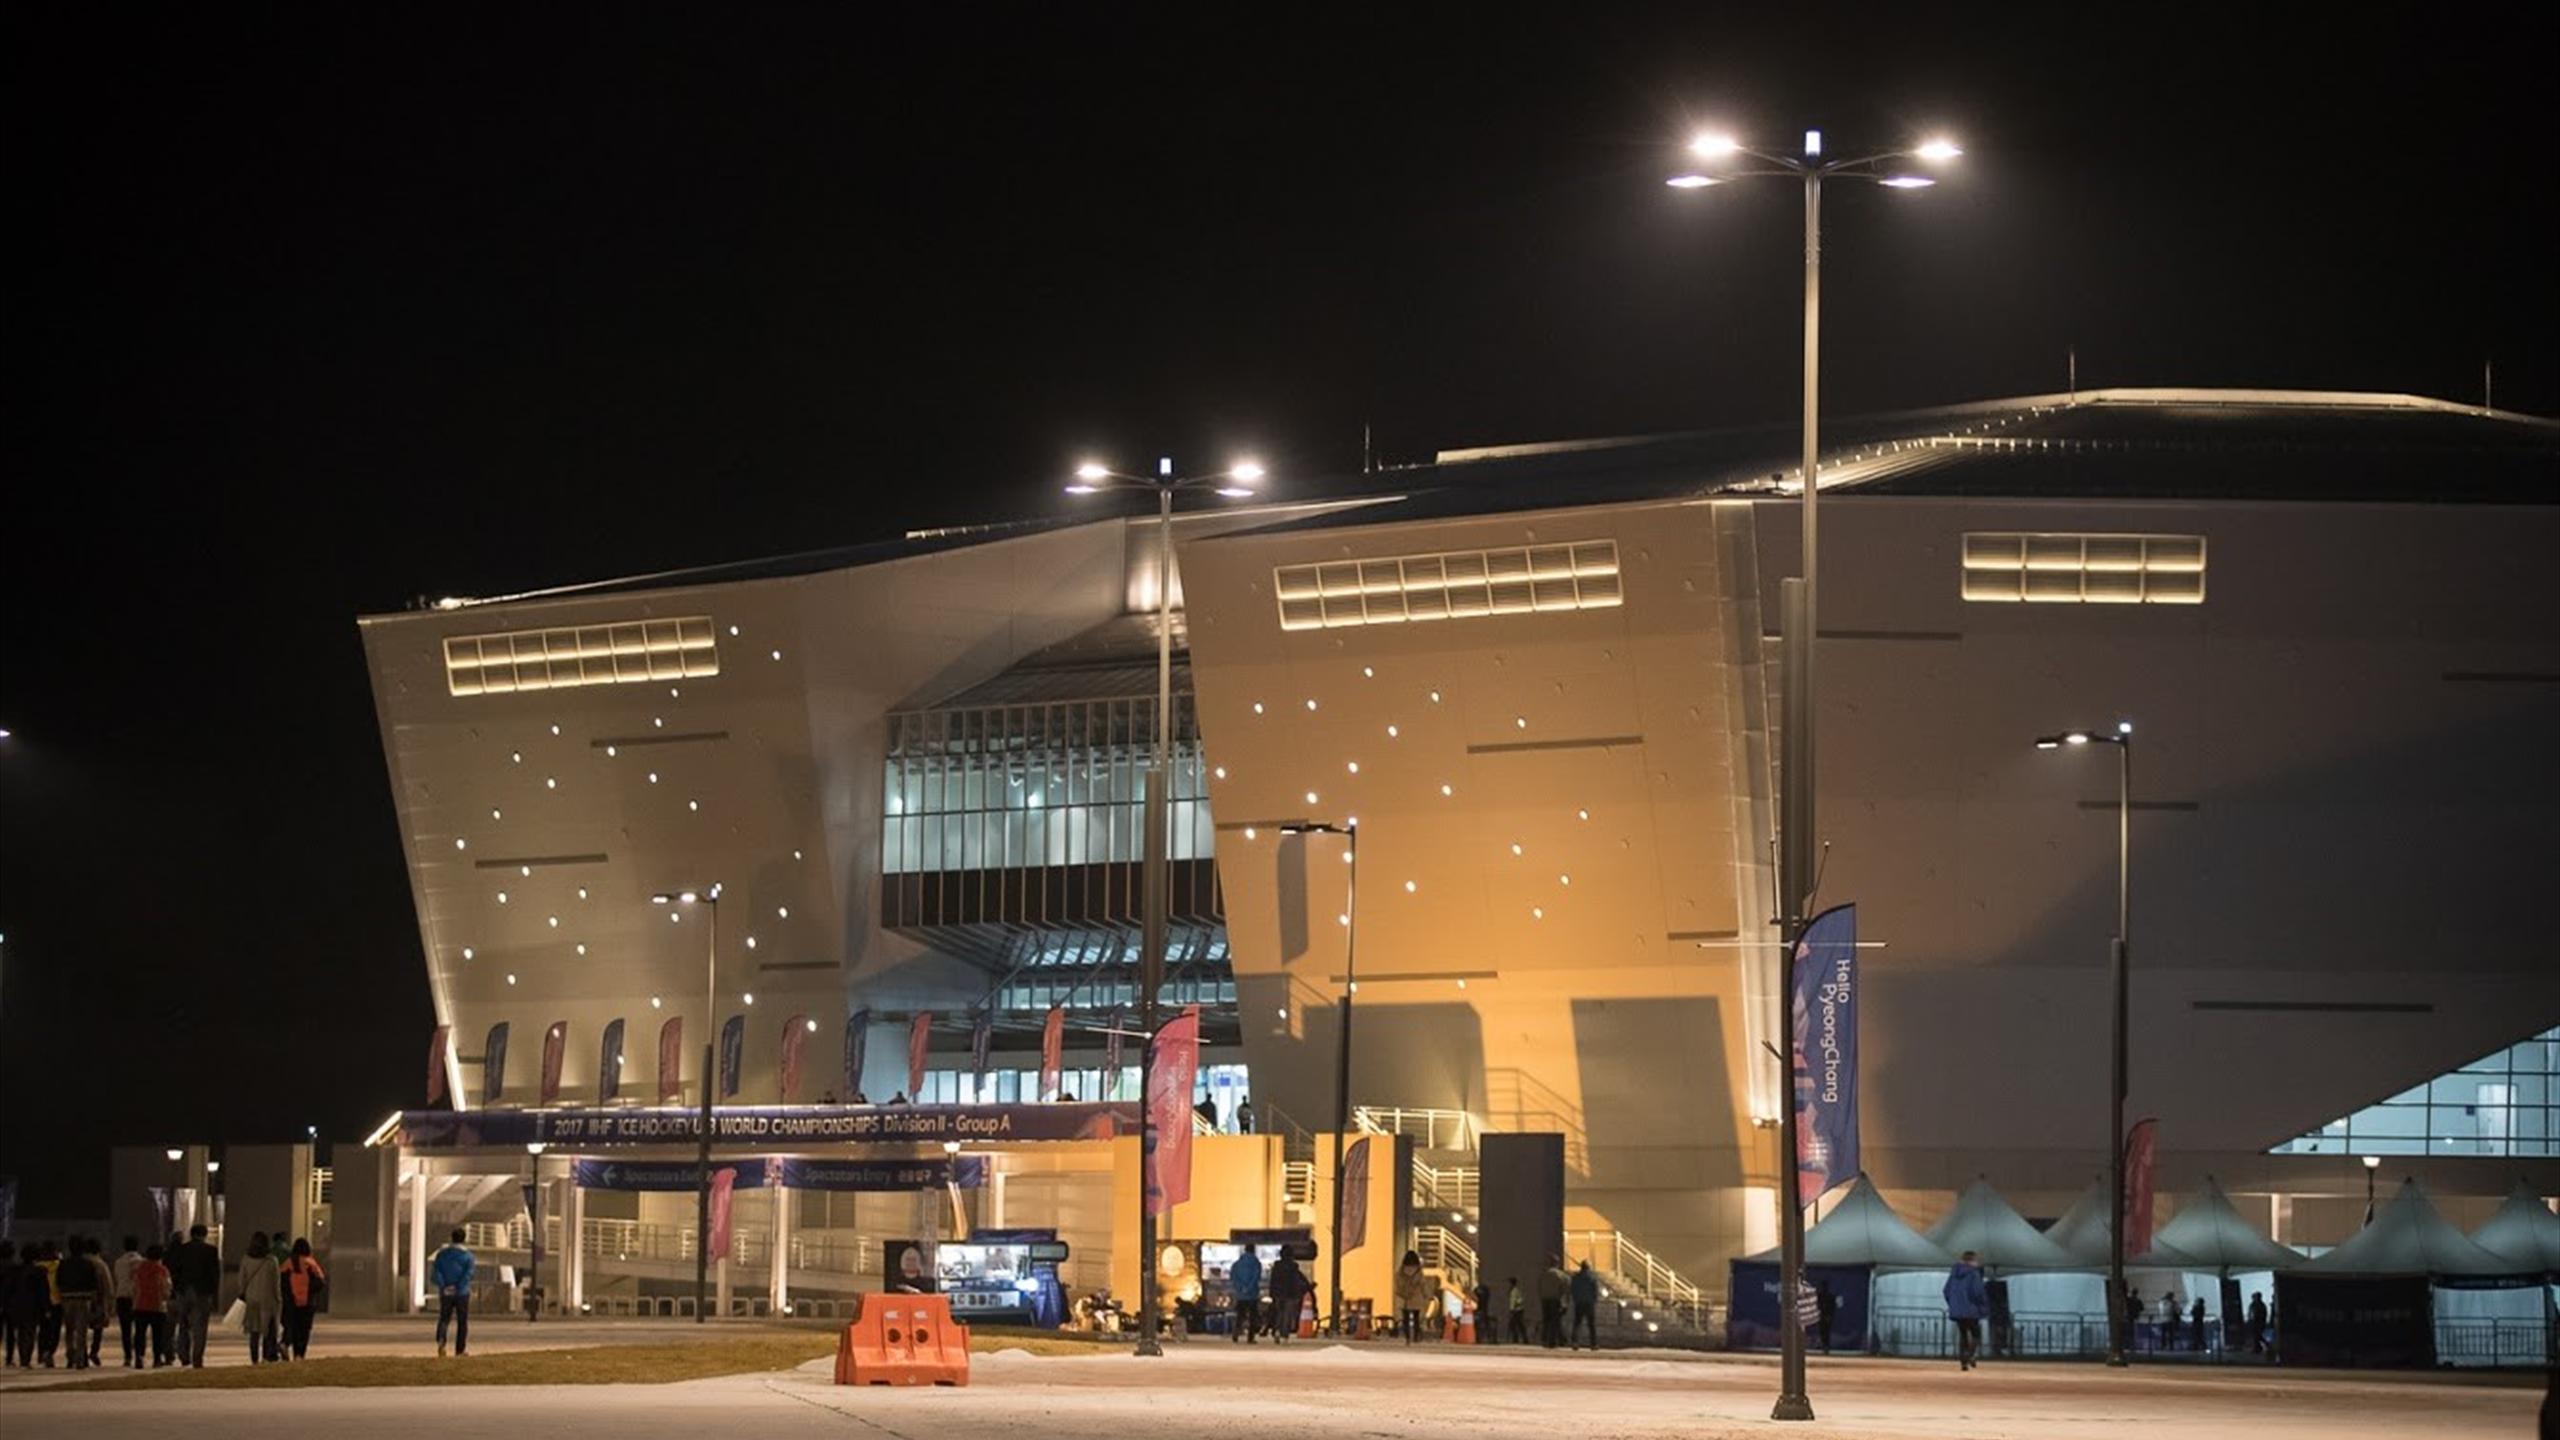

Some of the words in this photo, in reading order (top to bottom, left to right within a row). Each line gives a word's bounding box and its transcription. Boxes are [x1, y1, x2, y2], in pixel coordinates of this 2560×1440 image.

[1836, 959, 1851, 1004] Hello
[1820, 983, 1840, 1103] PyeongChang
[555, 1118, 583, 1136] 2017
[588, 1118, 613, 1136] IIHF
[618, 1118, 637, 1136] ICE
[641, 1117, 692, 1136] HOCKEY
[693, 1116, 716, 1135] U8
[720, 1116, 768, 1135] WORLD
[772, 1115, 879, 1135] CHAMPIONSHIPS
[884, 1114, 936, 1133] Division
[956, 1114, 999, 1135] Group
[1000, 1113, 1011, 1131] A
